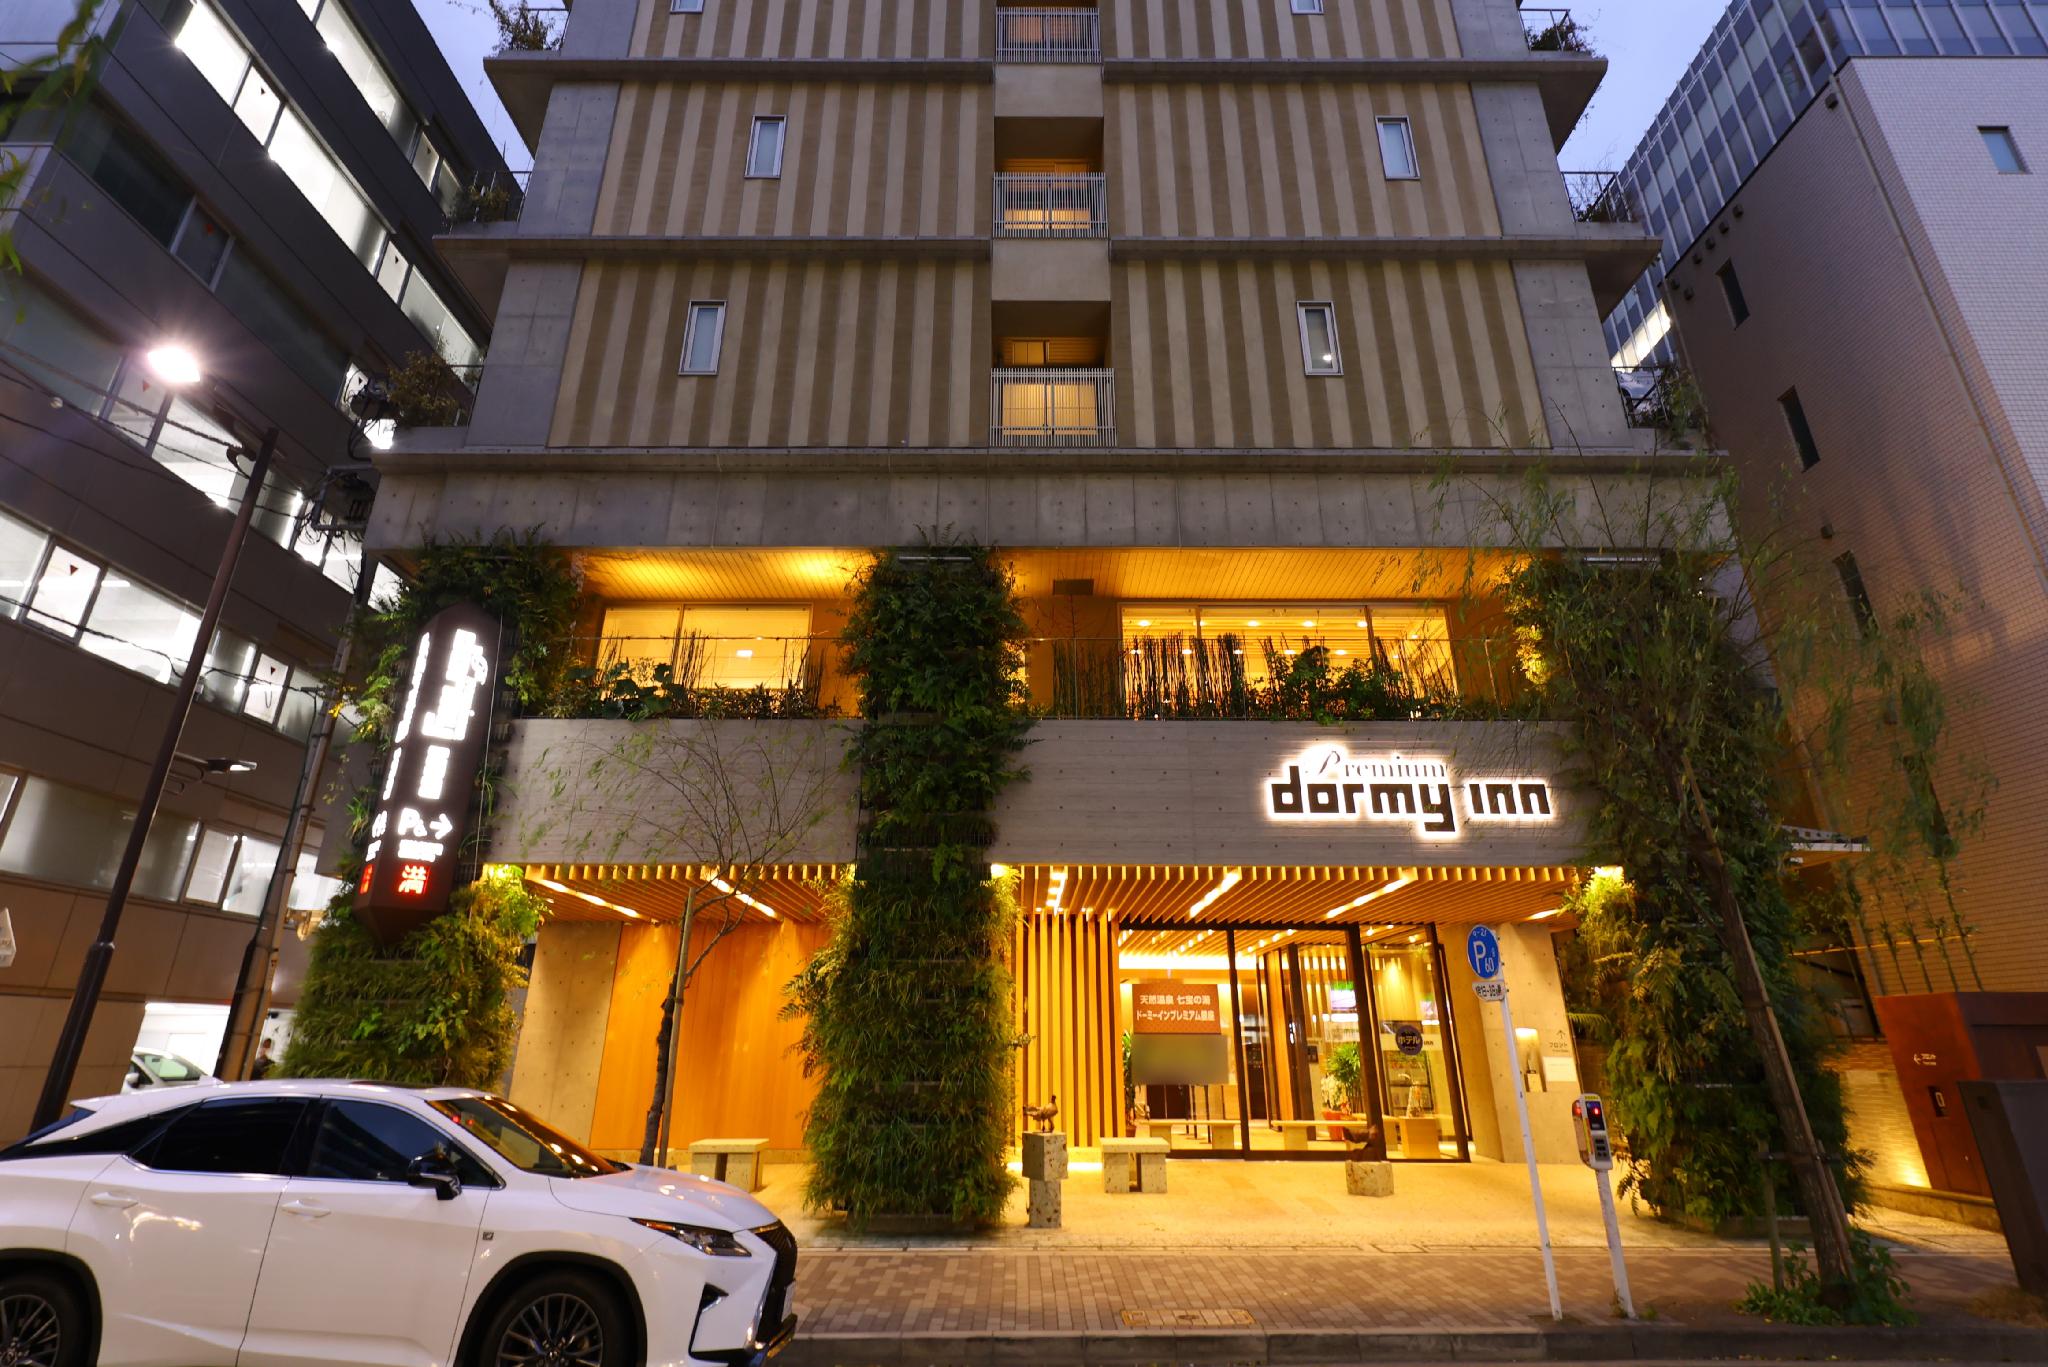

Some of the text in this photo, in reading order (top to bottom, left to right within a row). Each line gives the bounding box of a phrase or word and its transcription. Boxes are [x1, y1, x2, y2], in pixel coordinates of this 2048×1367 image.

[1304, 750, 1446, 777] Premium
[1271, 765, 1551, 832] dormy inn
[1473, 941, 1486, 974] P
[1485, 957, 1495, 973] 60
